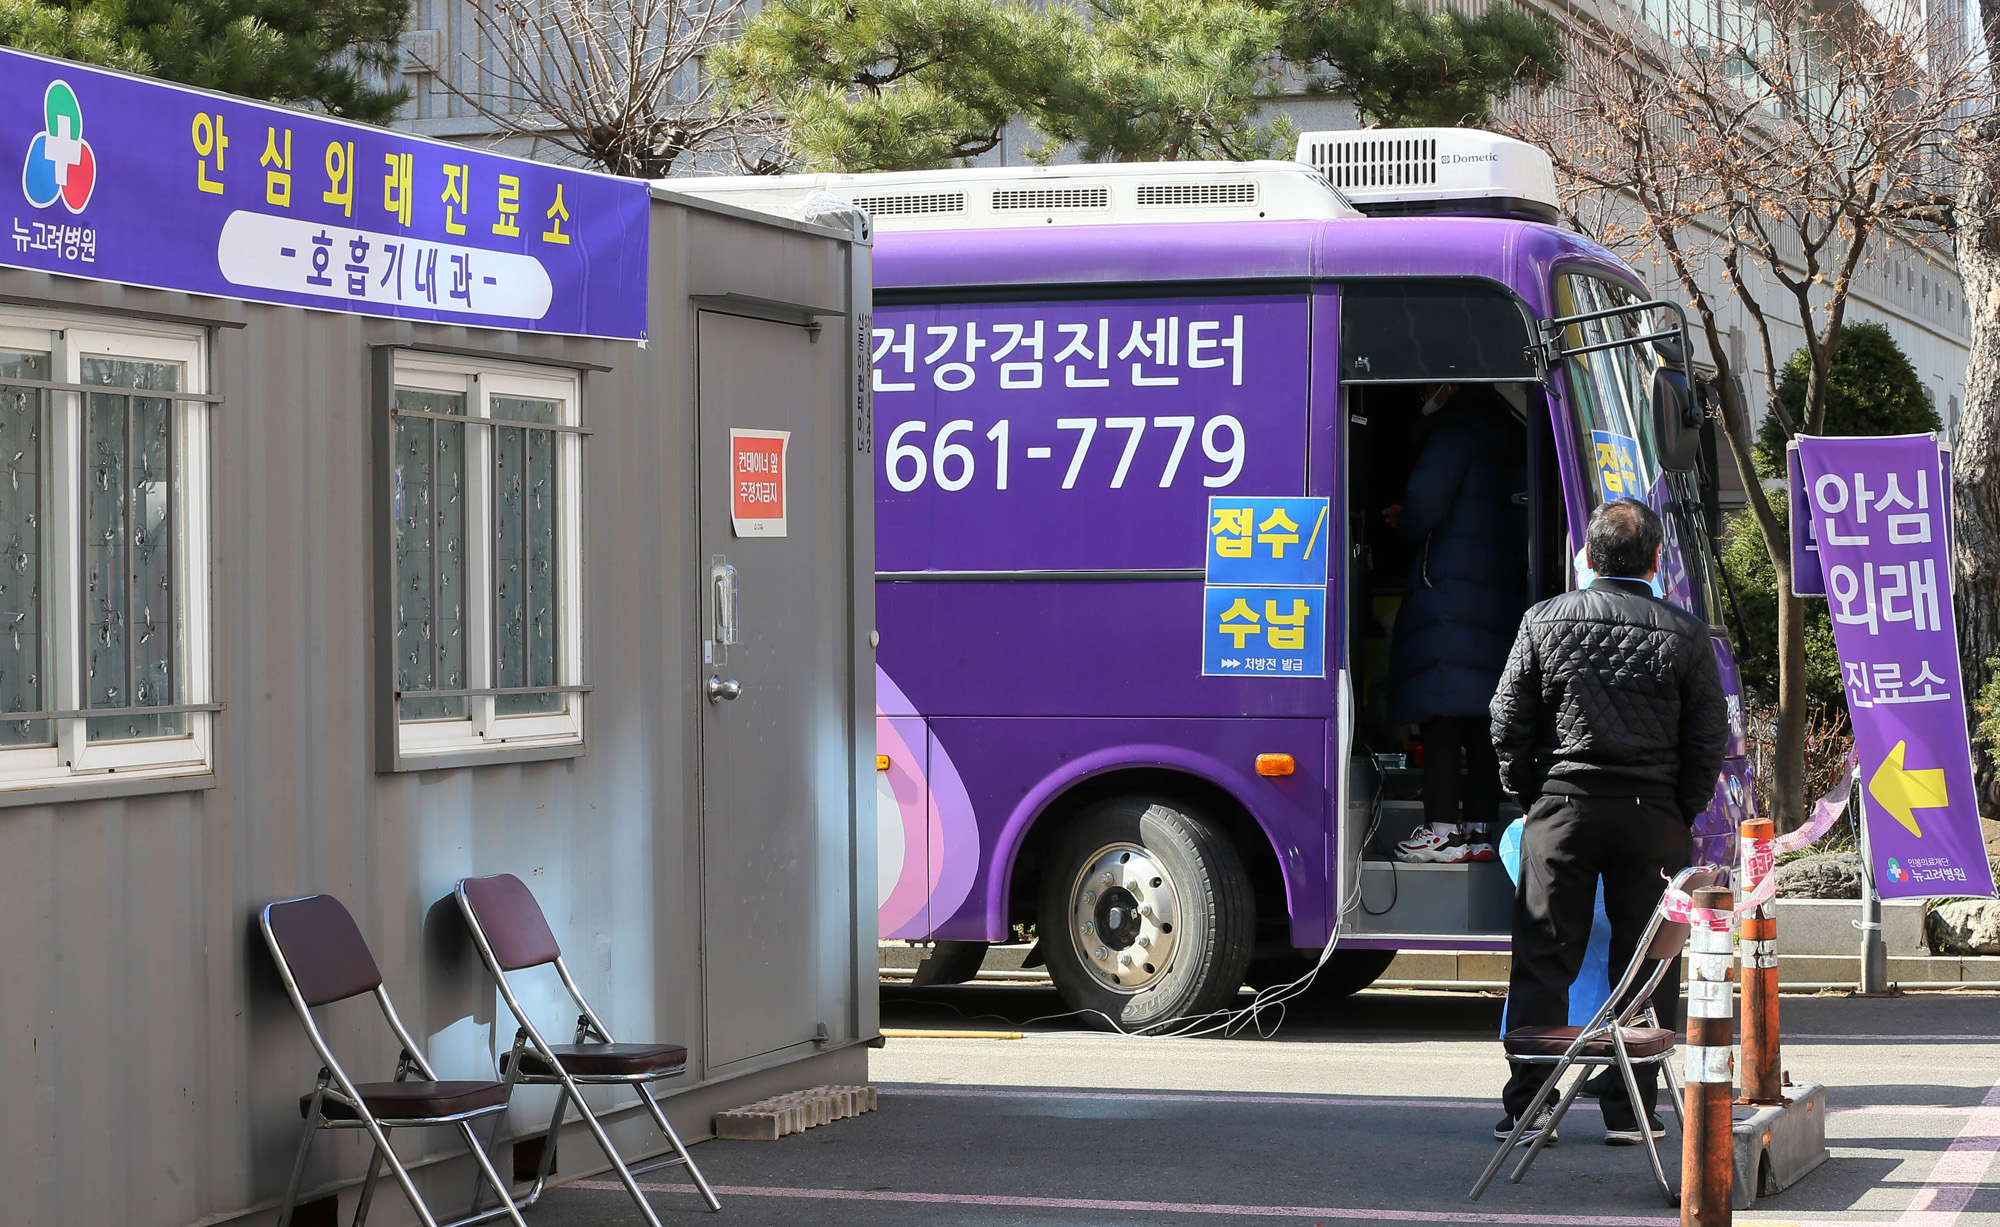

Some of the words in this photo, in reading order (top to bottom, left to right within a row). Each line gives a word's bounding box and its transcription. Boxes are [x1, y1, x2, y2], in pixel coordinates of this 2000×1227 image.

[1452, 152, 1499, 164] Dometic
[12, 217, 97, 264] 뉴고려병원
[872, 314, 1245, 393] 건강검진센터
[738, 451, 769, 474] 컨테이너
[770, 452, 779, 474] 앞
[885, 414, 1246, 492] 661-7779
[1815, 469, 1932, 547] 안심
[1829, 558, 1942, 636] 외래
[1218, 598, 1310, 651] 수납
[1244, 657, 1277, 671] 처방전
[1281, 658, 1303, 672] 발급
[1844, 659, 1951, 709] 진료소
[1907, 857, 1950, 868] 인봉의료재단
[1911, 867, 1968, 882] 뉴고려병원
